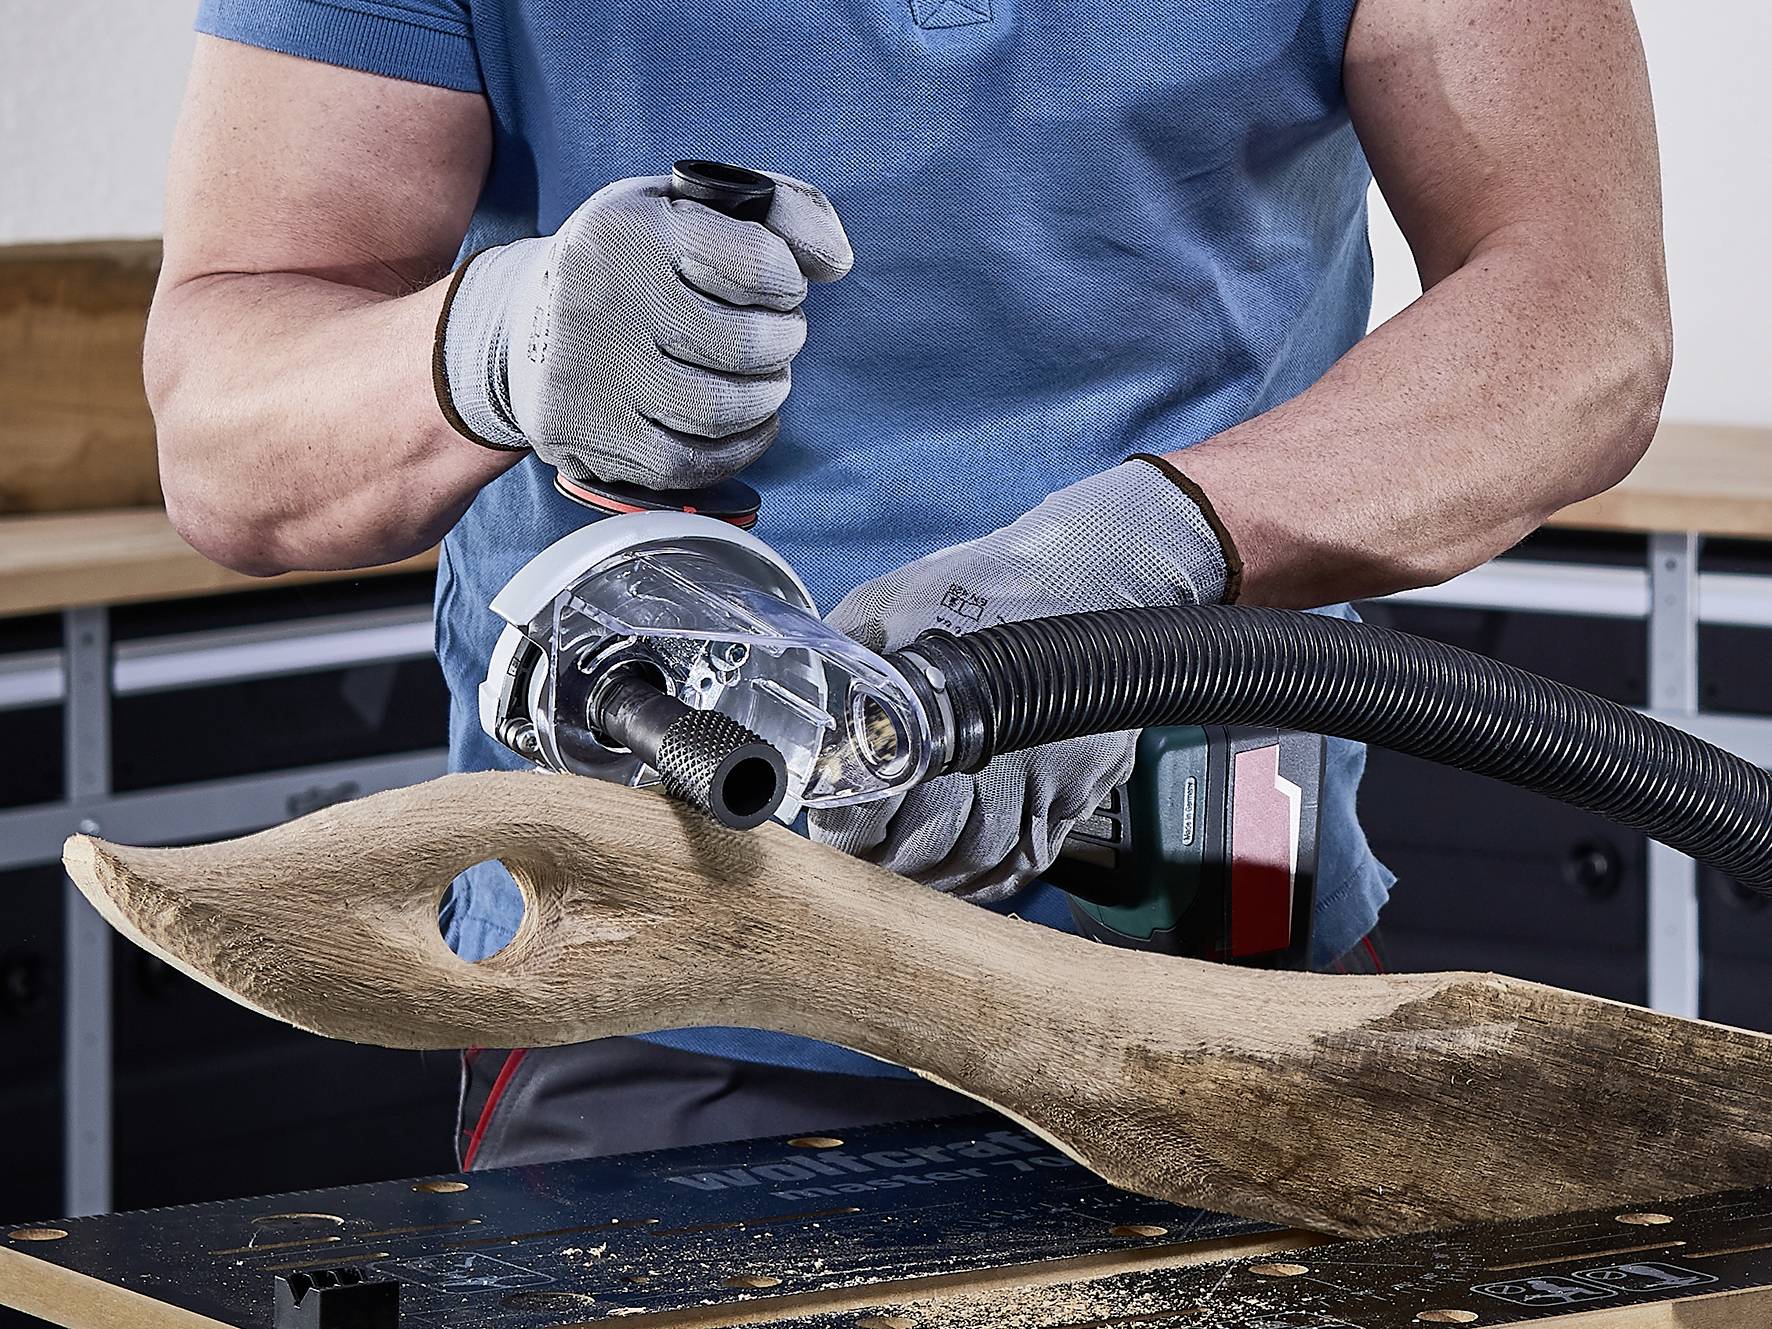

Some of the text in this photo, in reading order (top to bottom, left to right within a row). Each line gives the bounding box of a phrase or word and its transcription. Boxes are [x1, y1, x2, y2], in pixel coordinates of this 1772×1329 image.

[1185, 782, 1194, 812] Germany
[1183, 821, 1192, 841] Made
[664, 1130, 1044, 1191] wolfcraf
[769, 1168, 989, 1200] master
